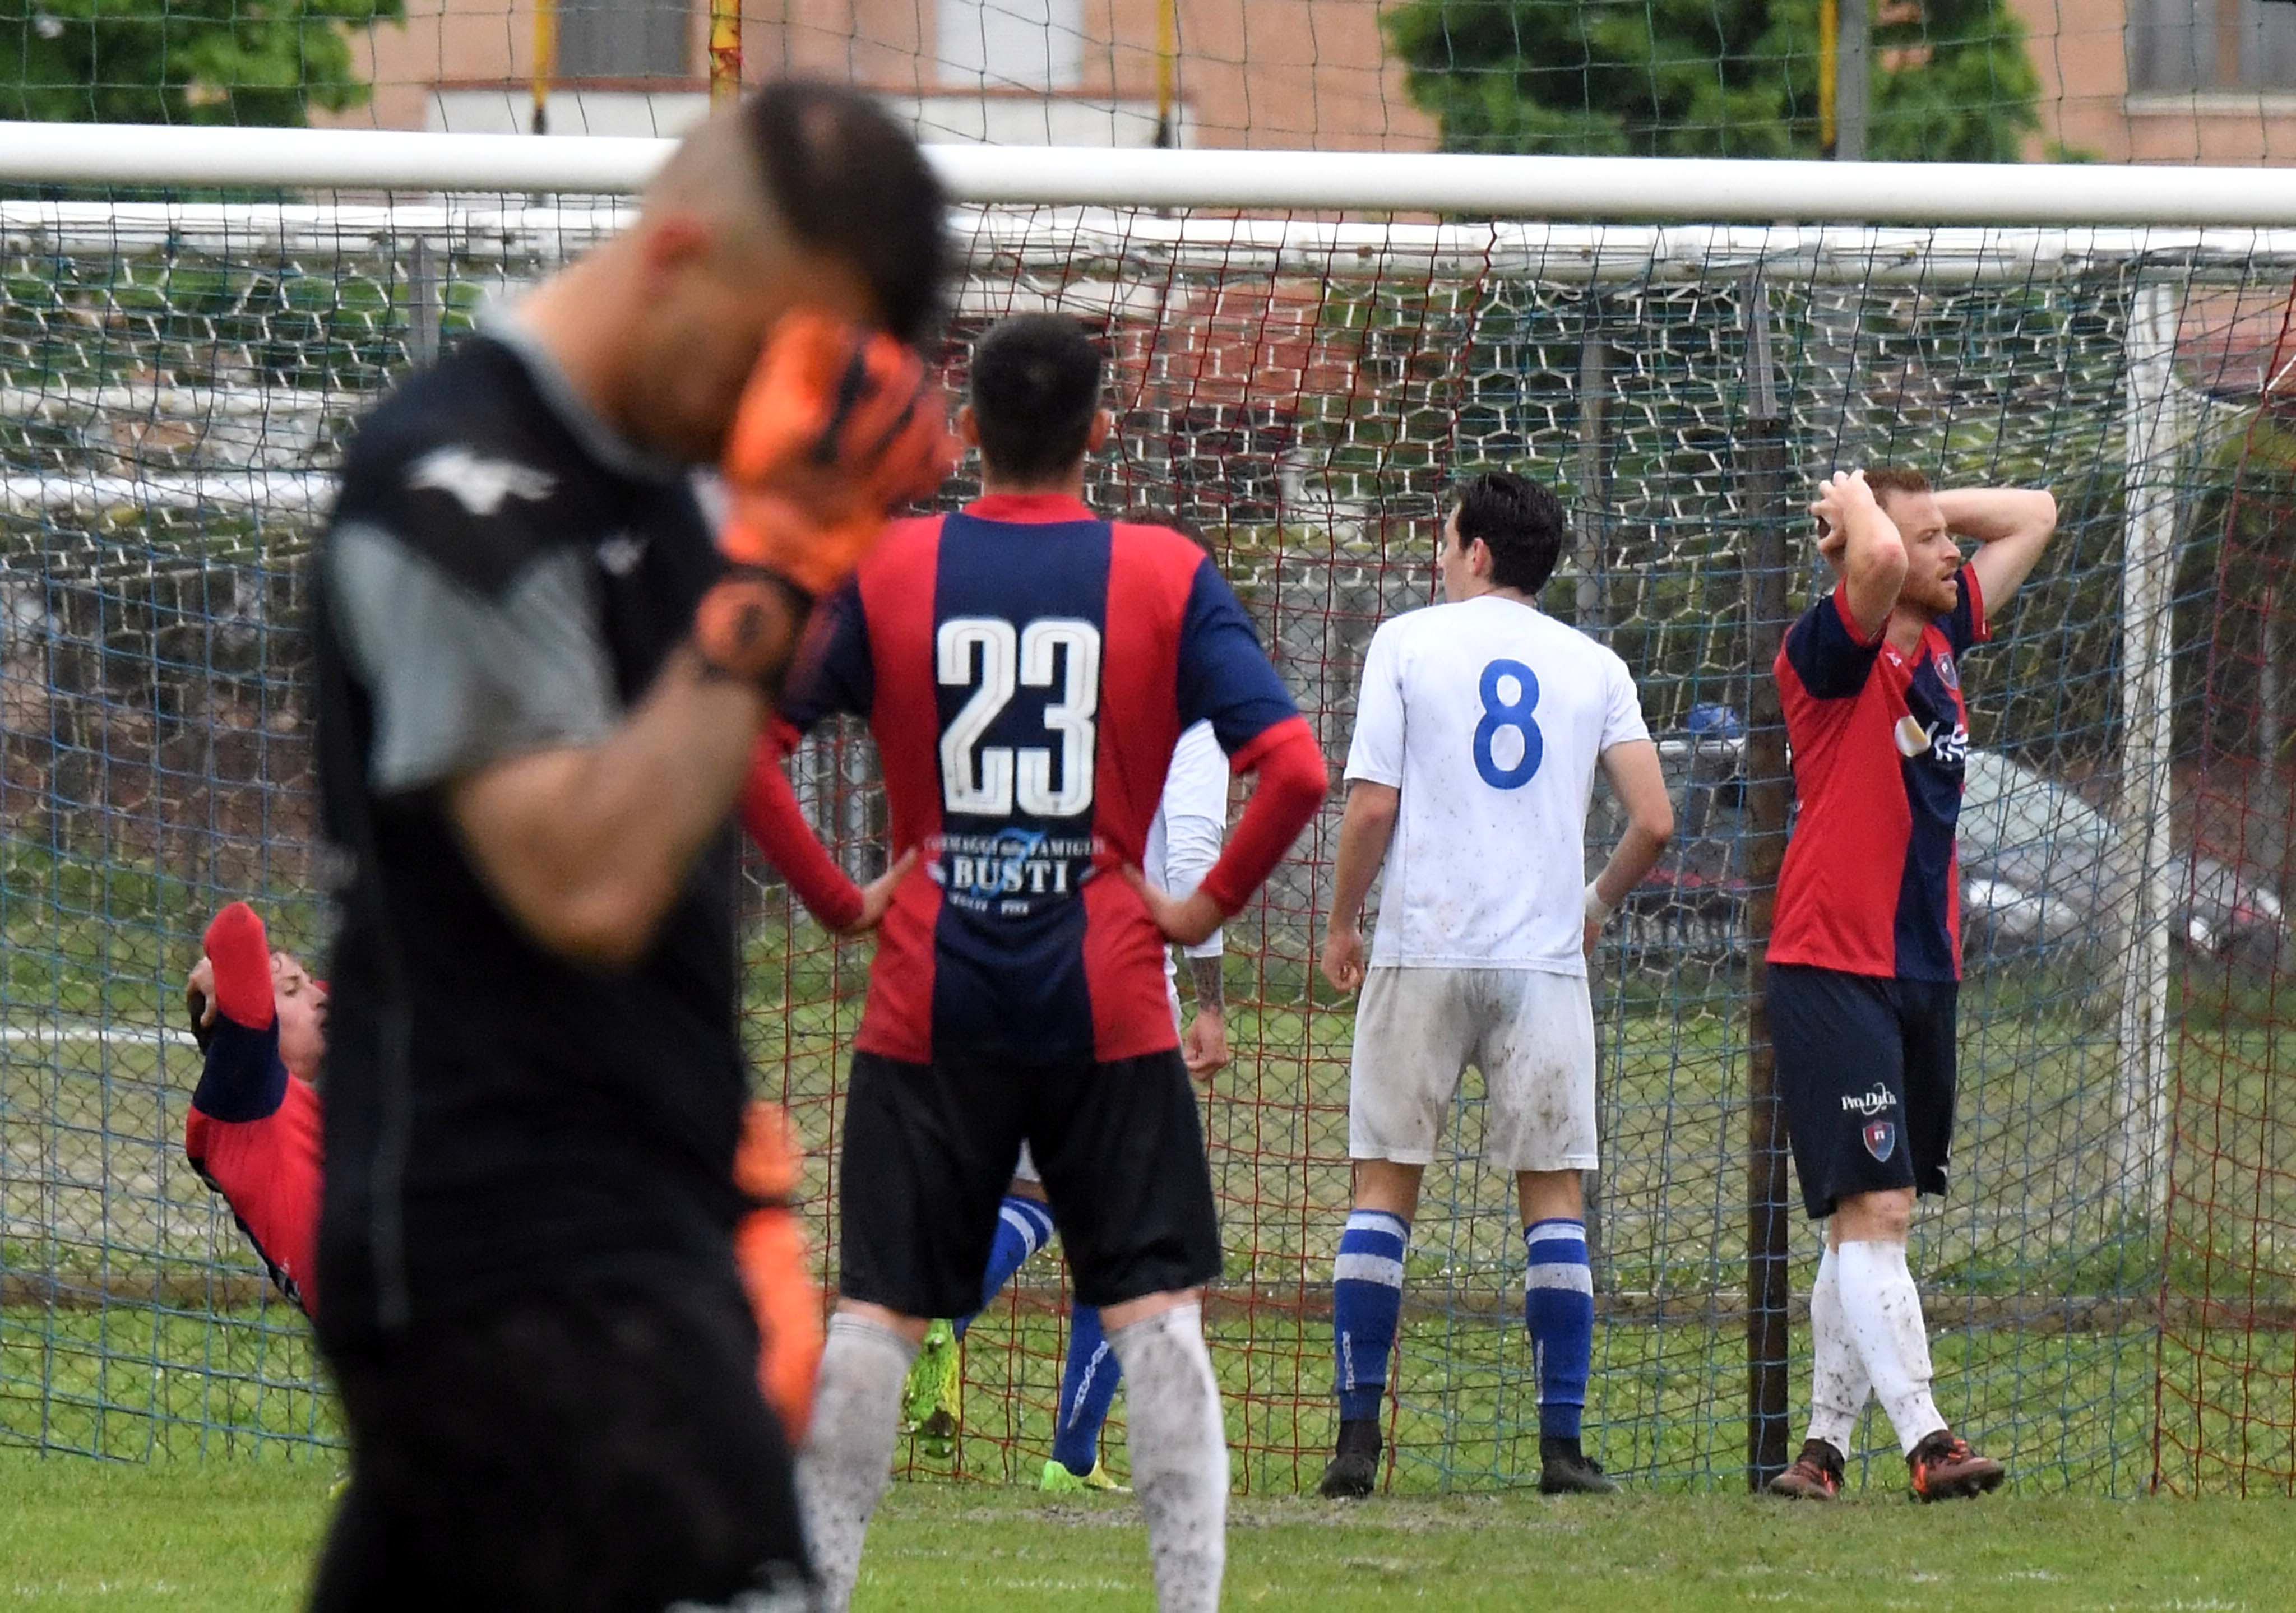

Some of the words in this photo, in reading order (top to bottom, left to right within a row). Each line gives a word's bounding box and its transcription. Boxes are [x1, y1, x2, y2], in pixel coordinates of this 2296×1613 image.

[937, 619, 1100, 817] 23
[1473, 658, 1544, 790] 8
[953, 856, 1068, 893] BUSTI
